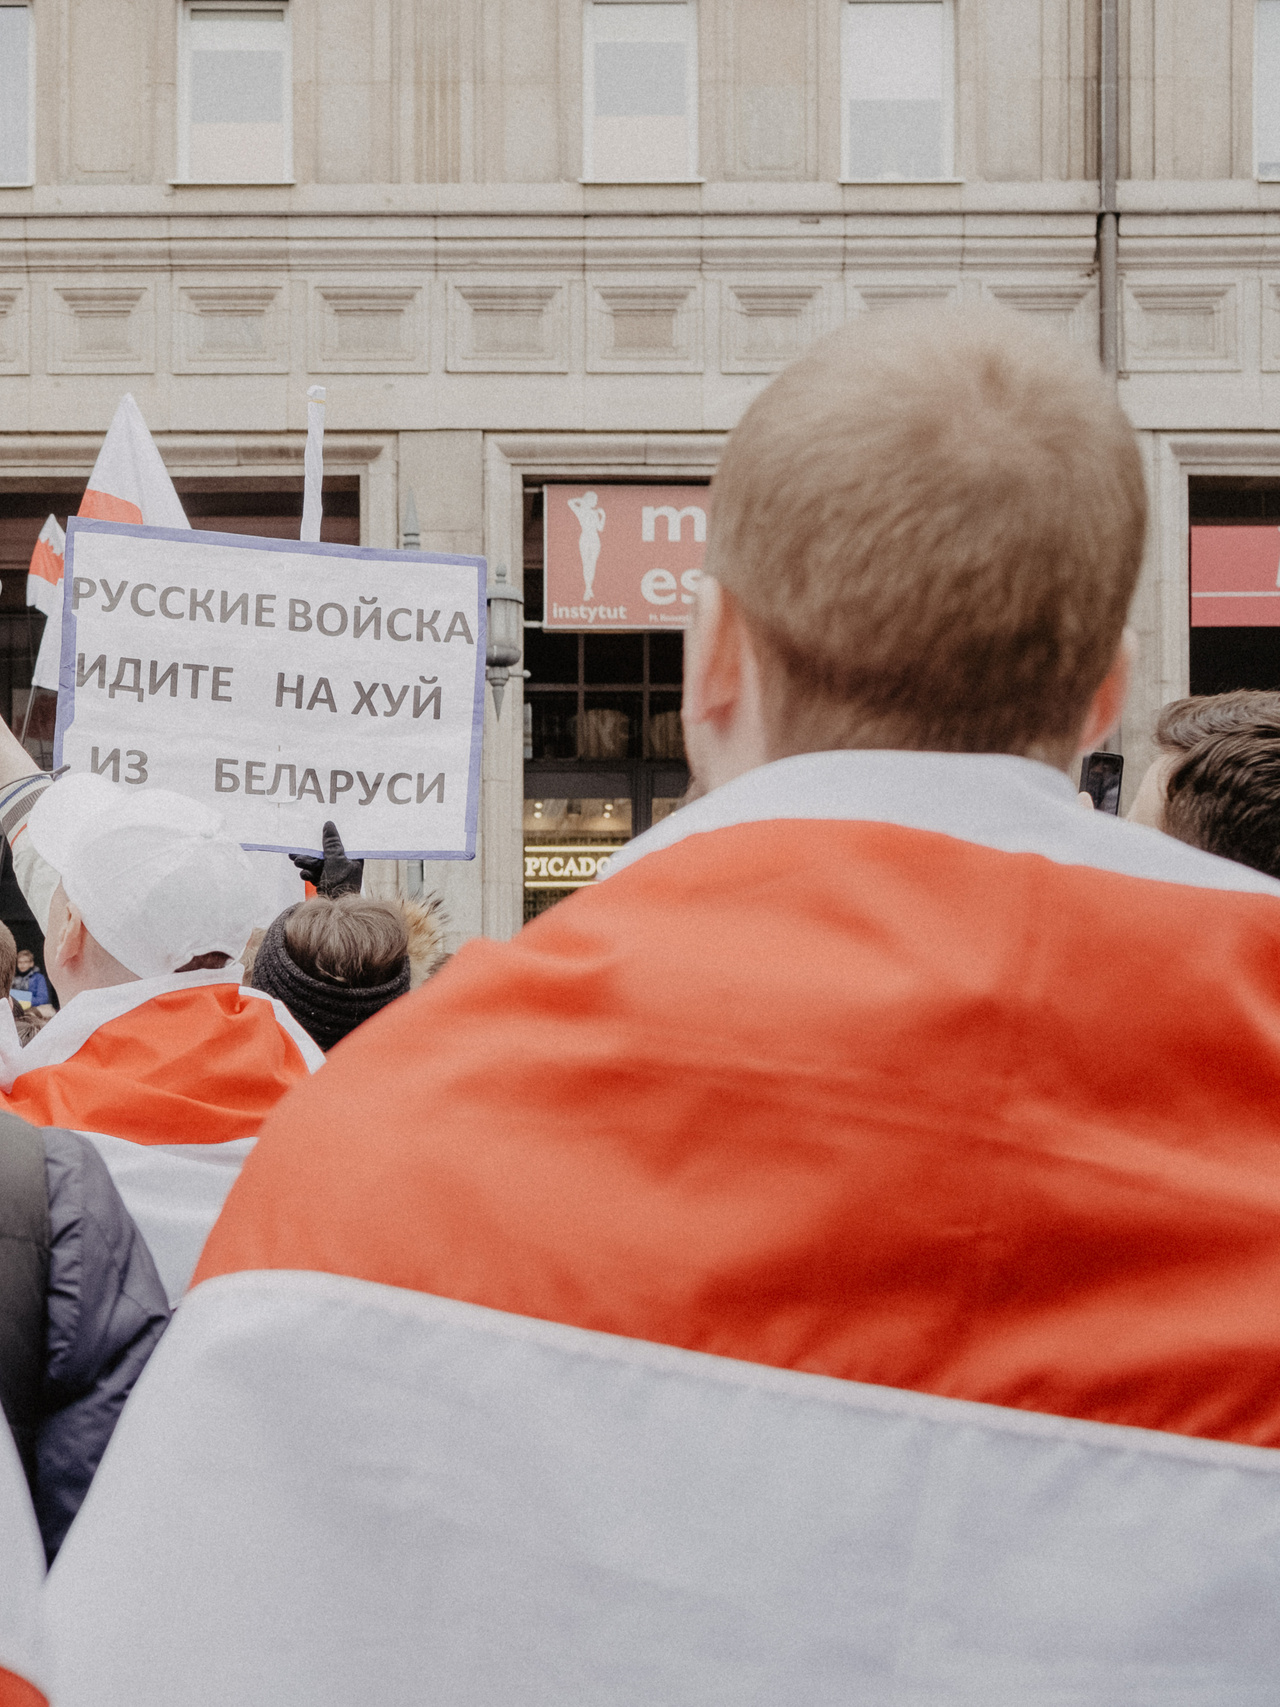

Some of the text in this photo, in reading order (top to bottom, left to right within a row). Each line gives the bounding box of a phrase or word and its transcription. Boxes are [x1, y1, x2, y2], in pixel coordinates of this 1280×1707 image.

[73, 577, 475, 645] РУССКИЕ ВОЙСКА
[552, 603, 627, 623] instytut
[76, 653, 443, 720] ИДИТЕ НА ХУЙ
[90, 746, 446, 806] ИЗ БЕЛАРУСИ
